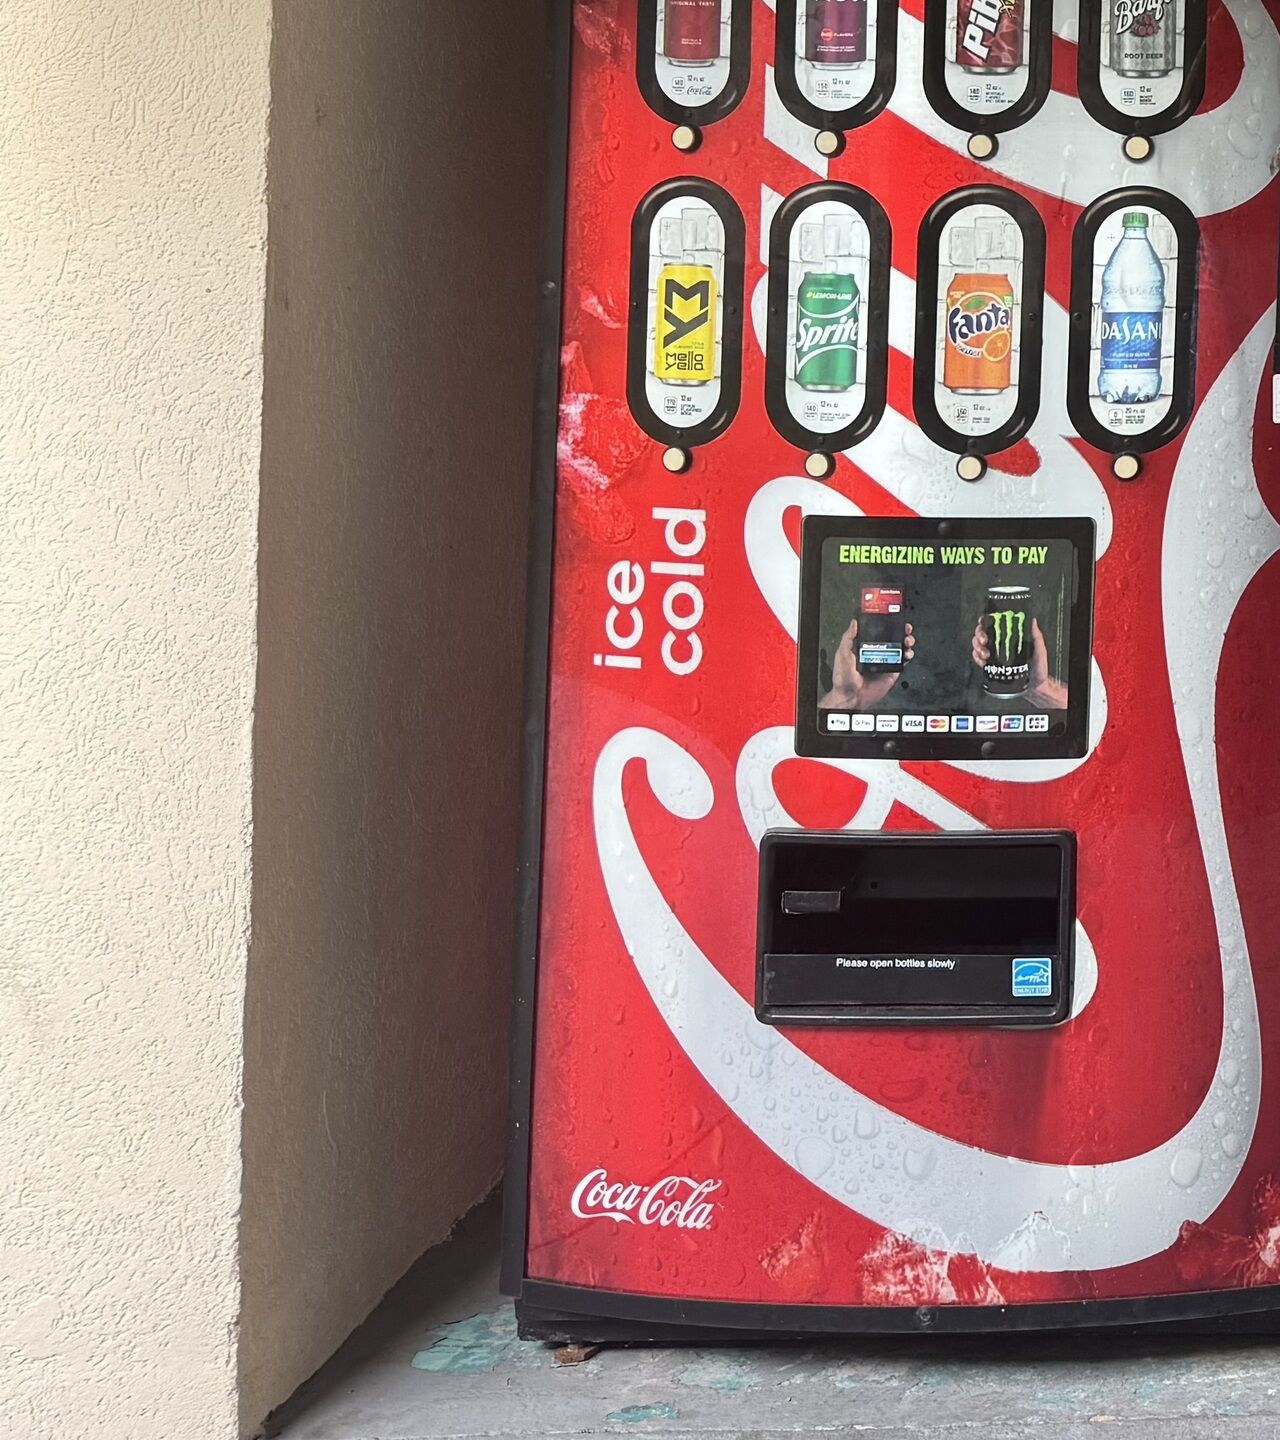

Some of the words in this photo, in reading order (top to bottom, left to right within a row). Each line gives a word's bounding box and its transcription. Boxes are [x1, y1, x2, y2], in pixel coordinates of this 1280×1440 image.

[797, 315, 859, 351] Sprite
[948, 303, 1010, 345] Fanta
[1101, 316, 1162, 345] DASANI
[665, 351, 704, 361] Mello
[839, 545, 934, 564] ENERGIZING
[940, 546, 985, 565] WAYS
[991, 546, 1012, 565] TO
[1018, 546, 1048, 564] PAY
[651, 506, 706, 675] cold
[593, 560, 645, 669] ice
[984, 664, 1029, 676] MONSTER
[836, 958, 868, 968] Please
[870, 960, 893, 969] open
[895, 958, 925, 968] bottles
[927, 958, 955, 970] slowly
[570, 1168, 722, 1229] Coca-Cola
